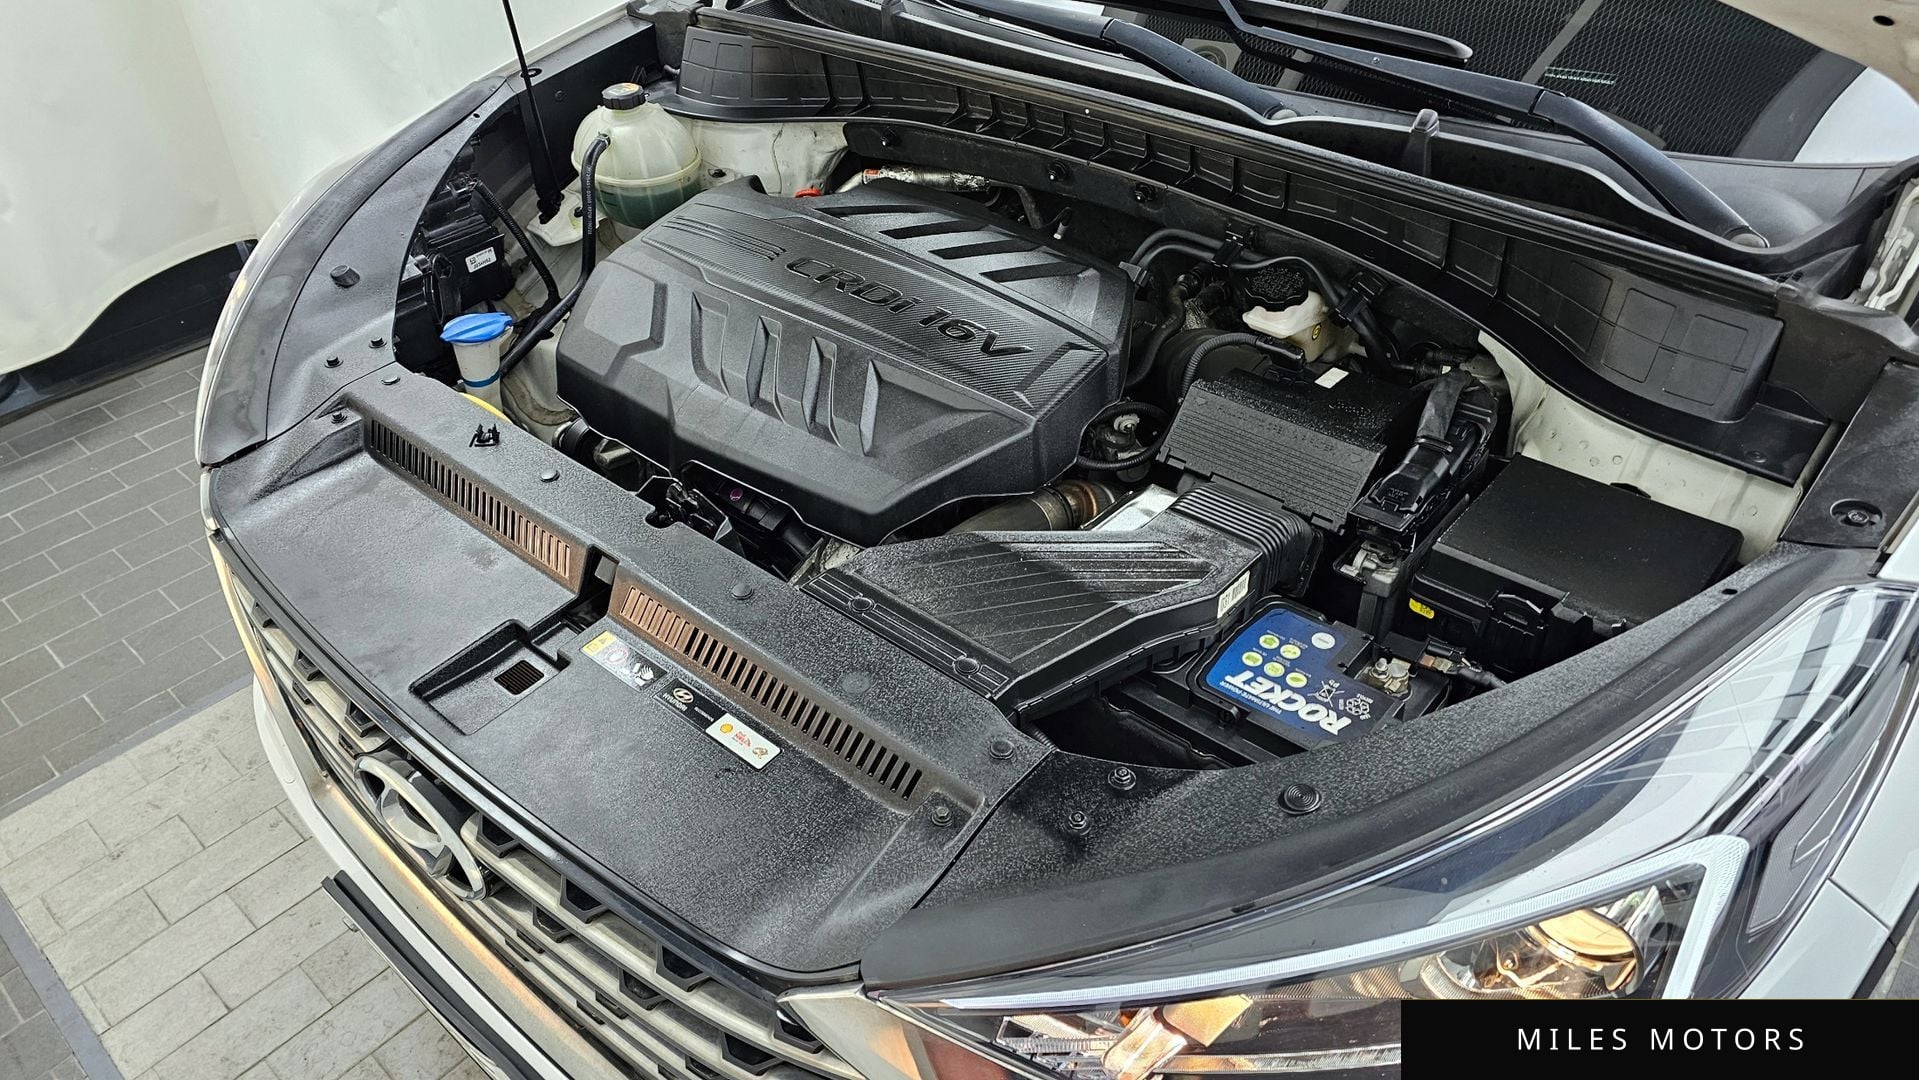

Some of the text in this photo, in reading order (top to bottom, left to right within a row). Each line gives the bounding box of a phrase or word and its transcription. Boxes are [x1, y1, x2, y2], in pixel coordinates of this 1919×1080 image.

[785, 257, 1034, 357] CRDi 16V
[662, 692, 688, 712] HYUNDAI
[1224, 670, 1352, 736] ROCKET
[1328, 679, 1340, 689] Pb
